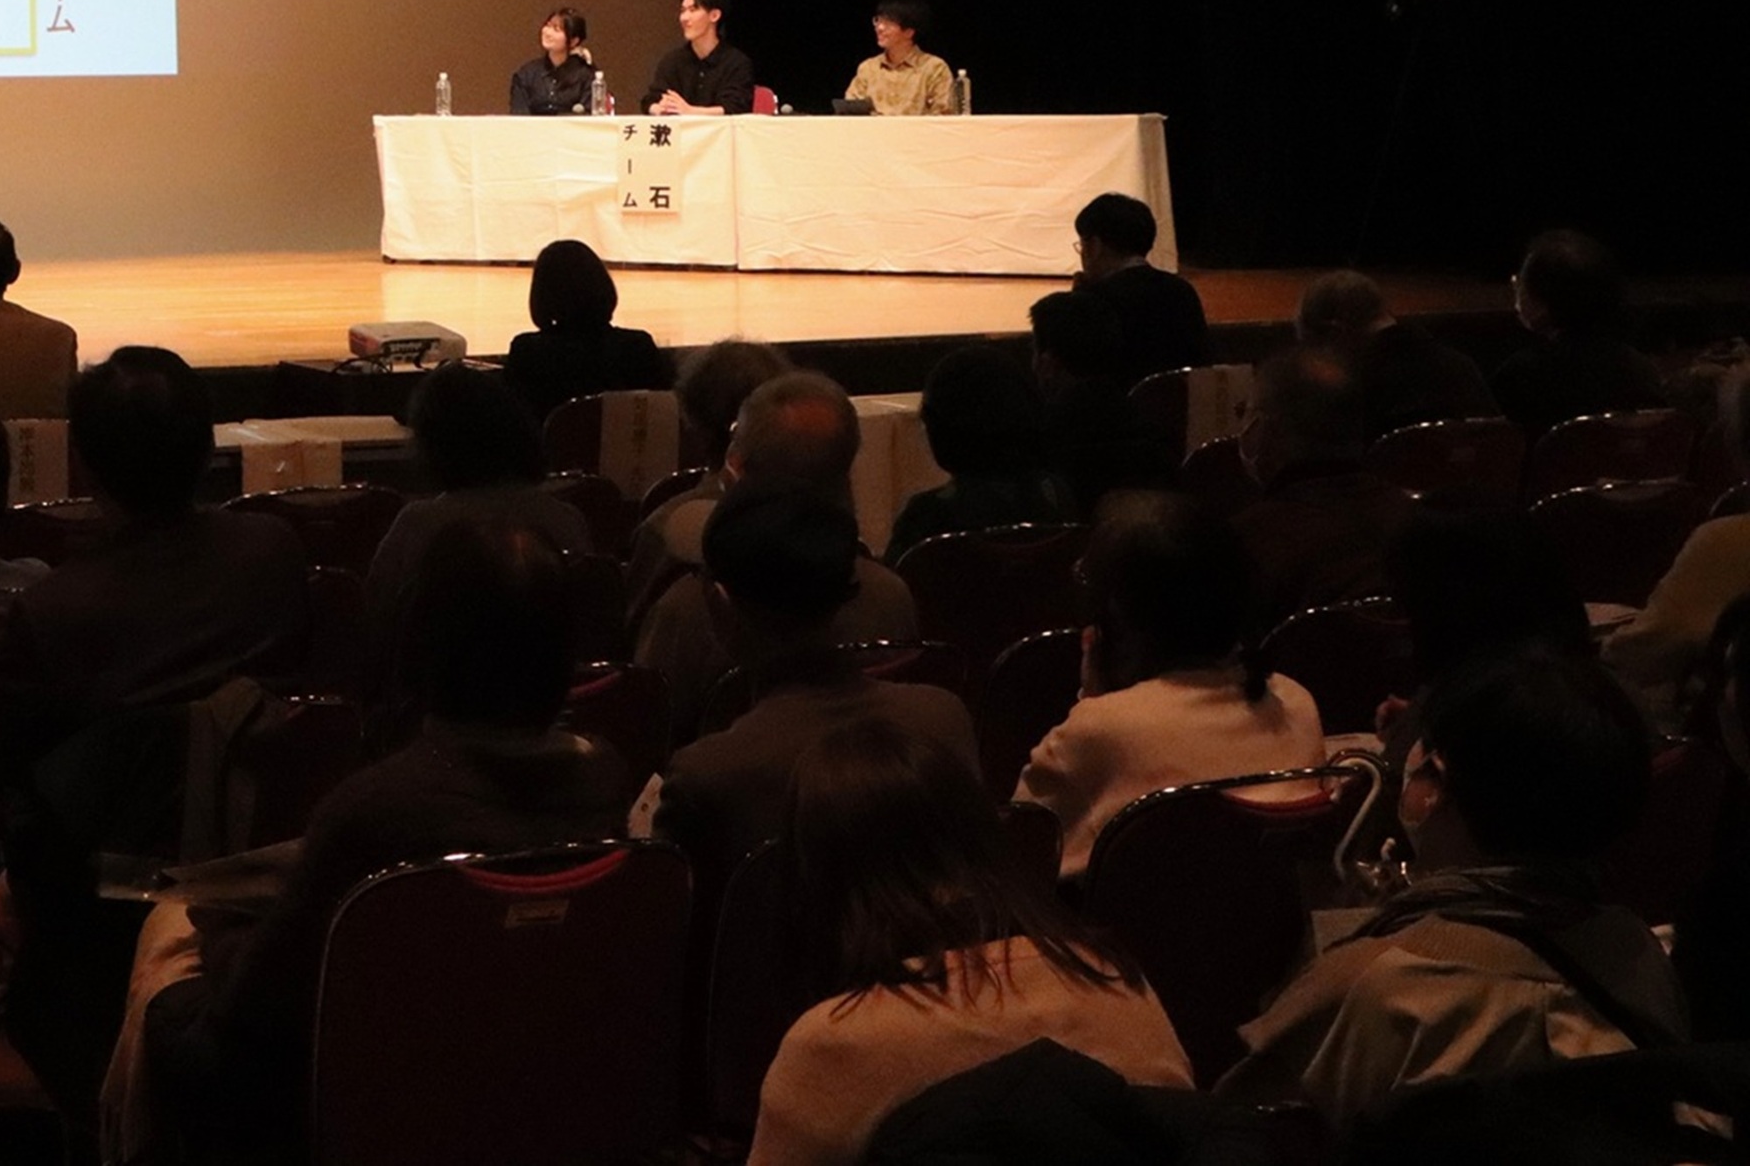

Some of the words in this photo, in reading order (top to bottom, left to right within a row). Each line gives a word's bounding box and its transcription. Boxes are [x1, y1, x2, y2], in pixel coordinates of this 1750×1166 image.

[622, 124, 638, 208] チーム
[649, 124, 672, 209] 漱石
